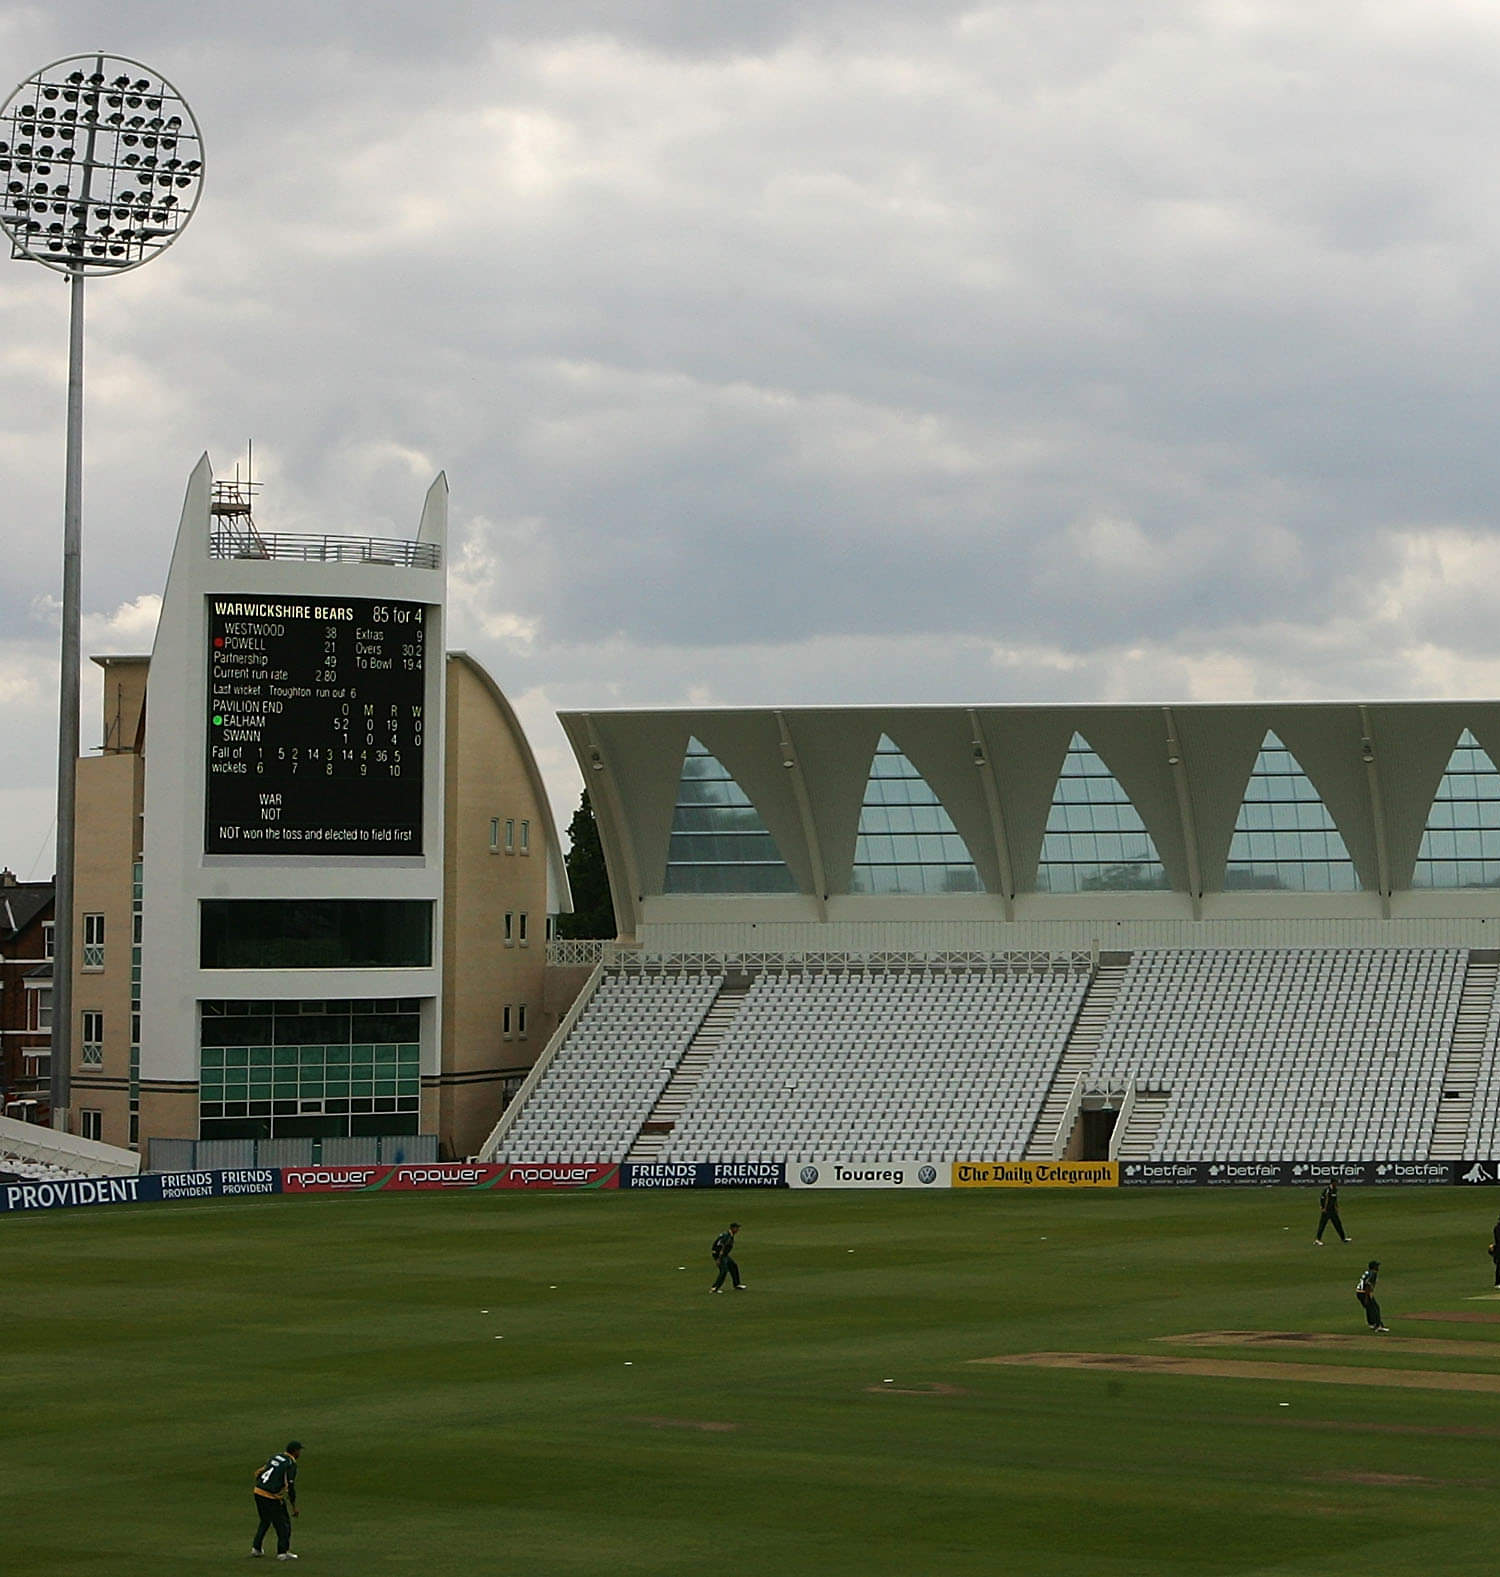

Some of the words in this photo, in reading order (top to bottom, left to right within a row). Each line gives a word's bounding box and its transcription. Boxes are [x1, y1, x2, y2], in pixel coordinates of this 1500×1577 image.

[215, 602, 311, 619] WARWICKSHIRE
[314, 606, 353, 620] BEARS
[372, 606, 389, 623] 85
[393, 607, 411, 623] for
[414, 608, 422, 623] 4
[225, 622, 285, 637] WESTWOOD
[325, 626, 337, 639] 38
[356, 628, 384, 640] Extras
[416, 630, 423, 642] 9
[225, 636, 266, 650] POWELL
[324, 641, 335, 653] 21
[356, 642, 382, 655] Overs
[214, 651, 268, 666] Partnership
[324, 656, 337, 668] 49
[356, 656, 367, 669] To
[370, 657, 392, 669] Bowl
[214, 666, 249, 679] Current
[252, 669, 268, 679] run
[271, 670, 289, 680] rate
[214, 683, 231, 695] Last
[269, 685, 311, 699] Troughton
[316, 687, 330, 697] run
[332, 688, 346, 698] out
[213, 699, 260, 713] PAVILION
[262, 701, 283, 714] END
[364, 704, 374, 716] M
[391, 704, 398, 717] R
[412, 705, 422, 718] W
[224, 714, 266, 727] EALHAM
[386, 720, 398, 732] 19
[224, 729, 261, 742] SWANN
[392, 734, 397, 745] 4
[212, 746, 230, 759] Fall
[232, 746, 242, 759] of
[278, 748, 285, 760] 5
[292, 748, 299, 760] 2
[308, 748, 319, 760] 14
[326, 748, 333, 761] 3
[342, 750, 353, 761] 14
[360, 750, 367, 761] 4
[376, 750, 388, 762] 36
[394, 750, 401, 763] 5
[212, 761, 248, 774] wickets
[256, 762, 264, 774] 6
[292, 762, 298, 774] 7
[326, 763, 333, 776] 8
[360, 764, 367, 776] 9
[390, 765, 401, 777] 10
[259, 794, 282, 805] WAR
[262, 808, 282, 820] NOT
[219, 826, 240, 839] NOT
[242, 829, 263, 839] won
[266, 828, 280, 840] the
[282, 828, 301, 840] toss
[305, 828, 322, 840] and
[324, 828, 357, 841] elected
[360, 830, 369, 841] to
[372, 828, 392, 841] field
[394, 830, 412, 841] first
[221, 1170, 273, 1183] FRIENDS
[399, 1168, 487, 1185] npower
[510, 1168, 597, 1184] npower
[632, 1165, 696, 1177] FRIENDS
[714, 1165, 779, 1176] FRIENDS
[834, 1166, 904, 1184] Touareg
[958, 1166, 988, 1182] The
[993, 1166, 1033, 1184] Daily
[1036, 1165, 1112, 1184] Telegraph
[1144, 1164, 1197, 1177] betfair
[1227, 1164, 1281, 1177] betfair
[1311, 1164, 1365, 1176] betfair
[1394, 1164, 1448, 1176] betfair
[161, 1172, 213, 1188] FRIENDS
[288, 1170, 375, 1188] npower
[631, 1178, 696, 1187] PROVIDENT
[7, 1178, 140, 1209] PROVIDENT
[162, 1186, 213, 1199] PROVIDENT
[222, 1184, 273, 1194] PROVIDENT
[261, 1466, 274, 1484] 4
